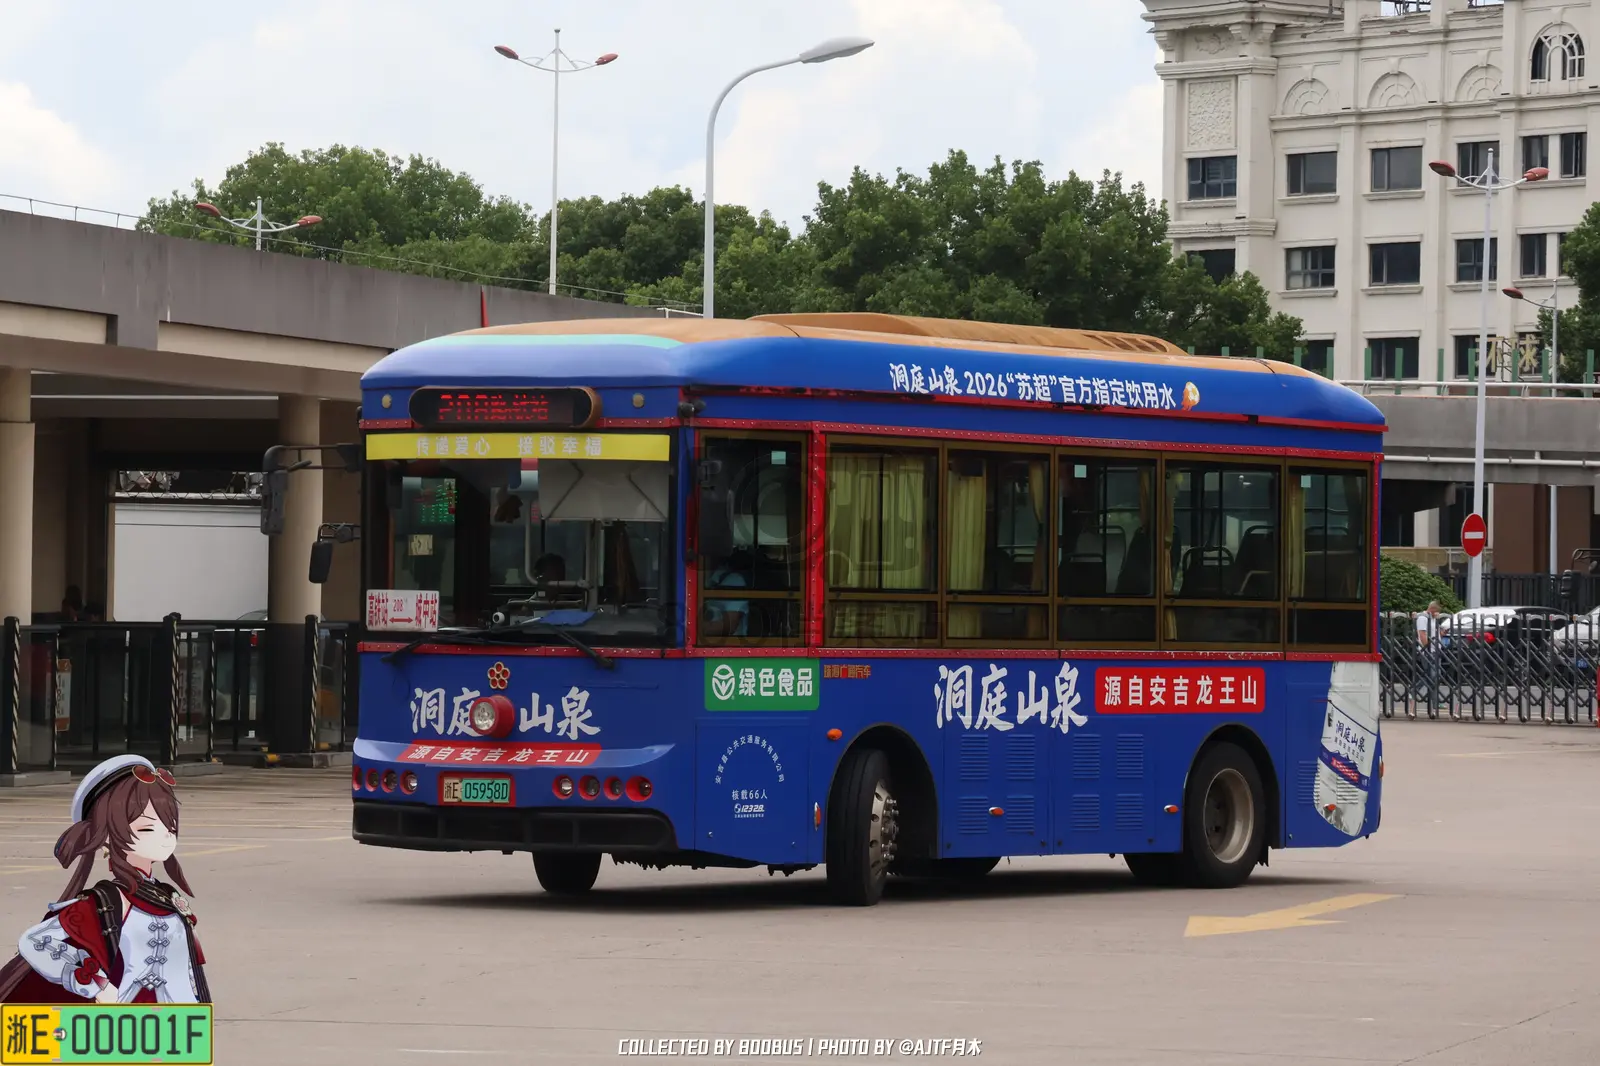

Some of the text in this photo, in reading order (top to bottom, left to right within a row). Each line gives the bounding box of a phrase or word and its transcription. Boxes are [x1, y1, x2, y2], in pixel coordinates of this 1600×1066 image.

[889, 362, 962, 396] 洞庭山泉
[416, 436, 602, 456] 传递爱心 接驳幸福
[739, 668, 812, 696] 绿色食品
[1104, 675, 1257, 706] 源自安吉龙王山
[934, 661, 1088, 733] 洞庭山泉
[407, 745, 591, 764] 源自安吉龙王山
